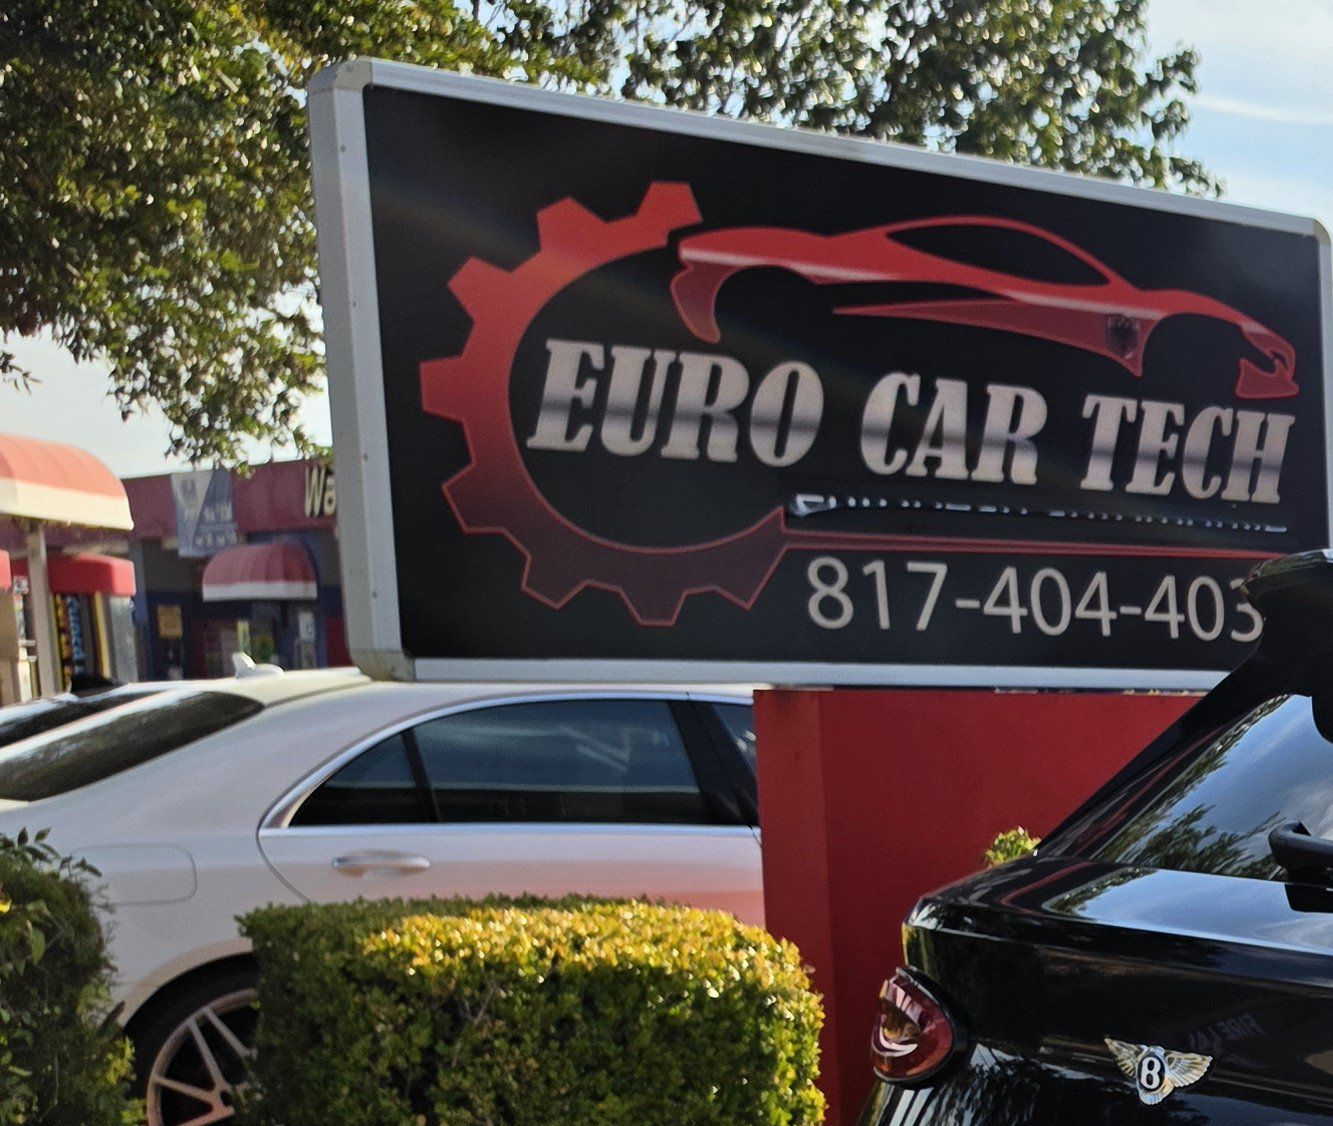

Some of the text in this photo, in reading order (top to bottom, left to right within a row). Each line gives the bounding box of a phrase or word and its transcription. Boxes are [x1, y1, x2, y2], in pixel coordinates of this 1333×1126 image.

[526, 338, 1296, 504] EURO CAR TECH
[807, 555, 1264, 643] 817-404-403
